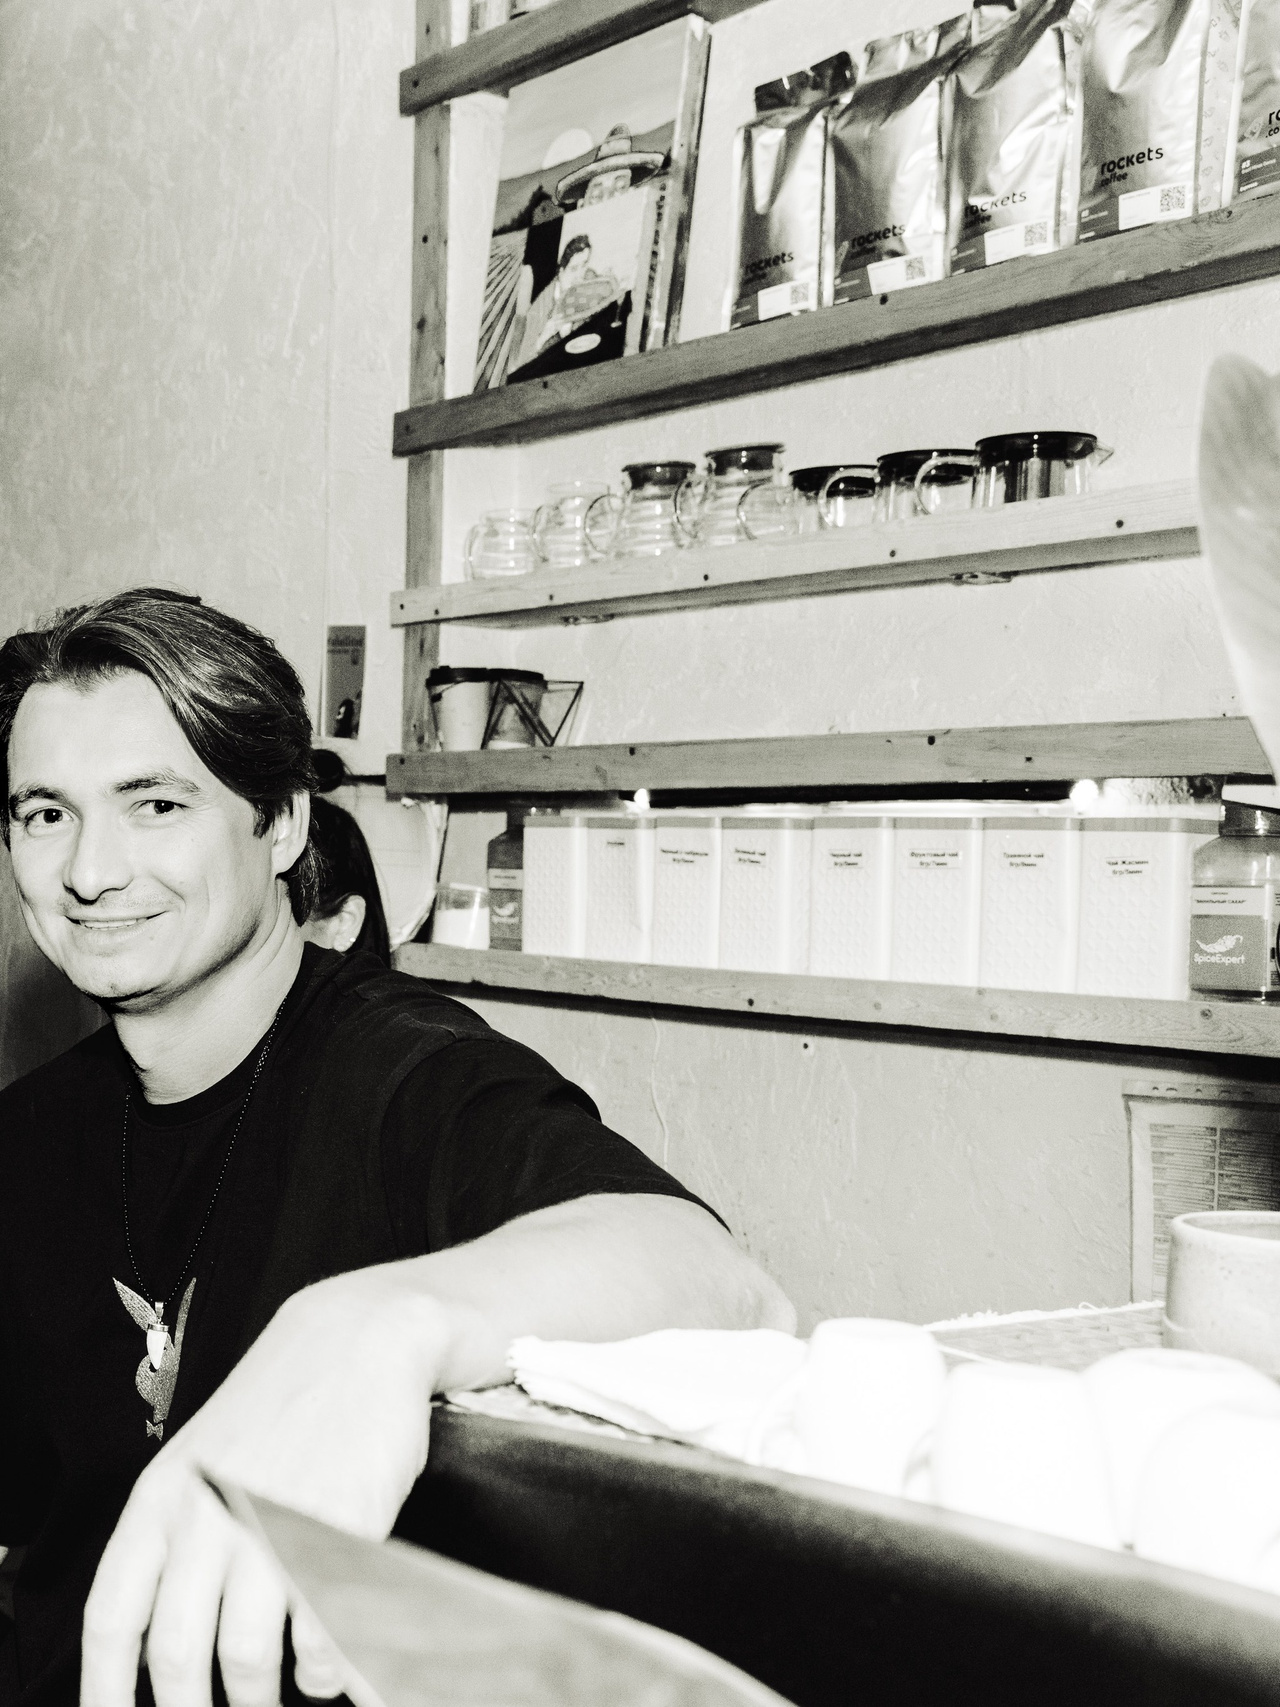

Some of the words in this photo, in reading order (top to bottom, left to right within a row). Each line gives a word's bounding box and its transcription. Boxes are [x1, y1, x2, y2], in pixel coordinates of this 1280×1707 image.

[1100, 147, 1164, 176] rockets
[964, 191, 1027, 219] rockets
[851, 224, 906, 250] rockets
[744, 252, 794, 276] rockets
[1193, 952, 1245, 966] SpiceExpert
